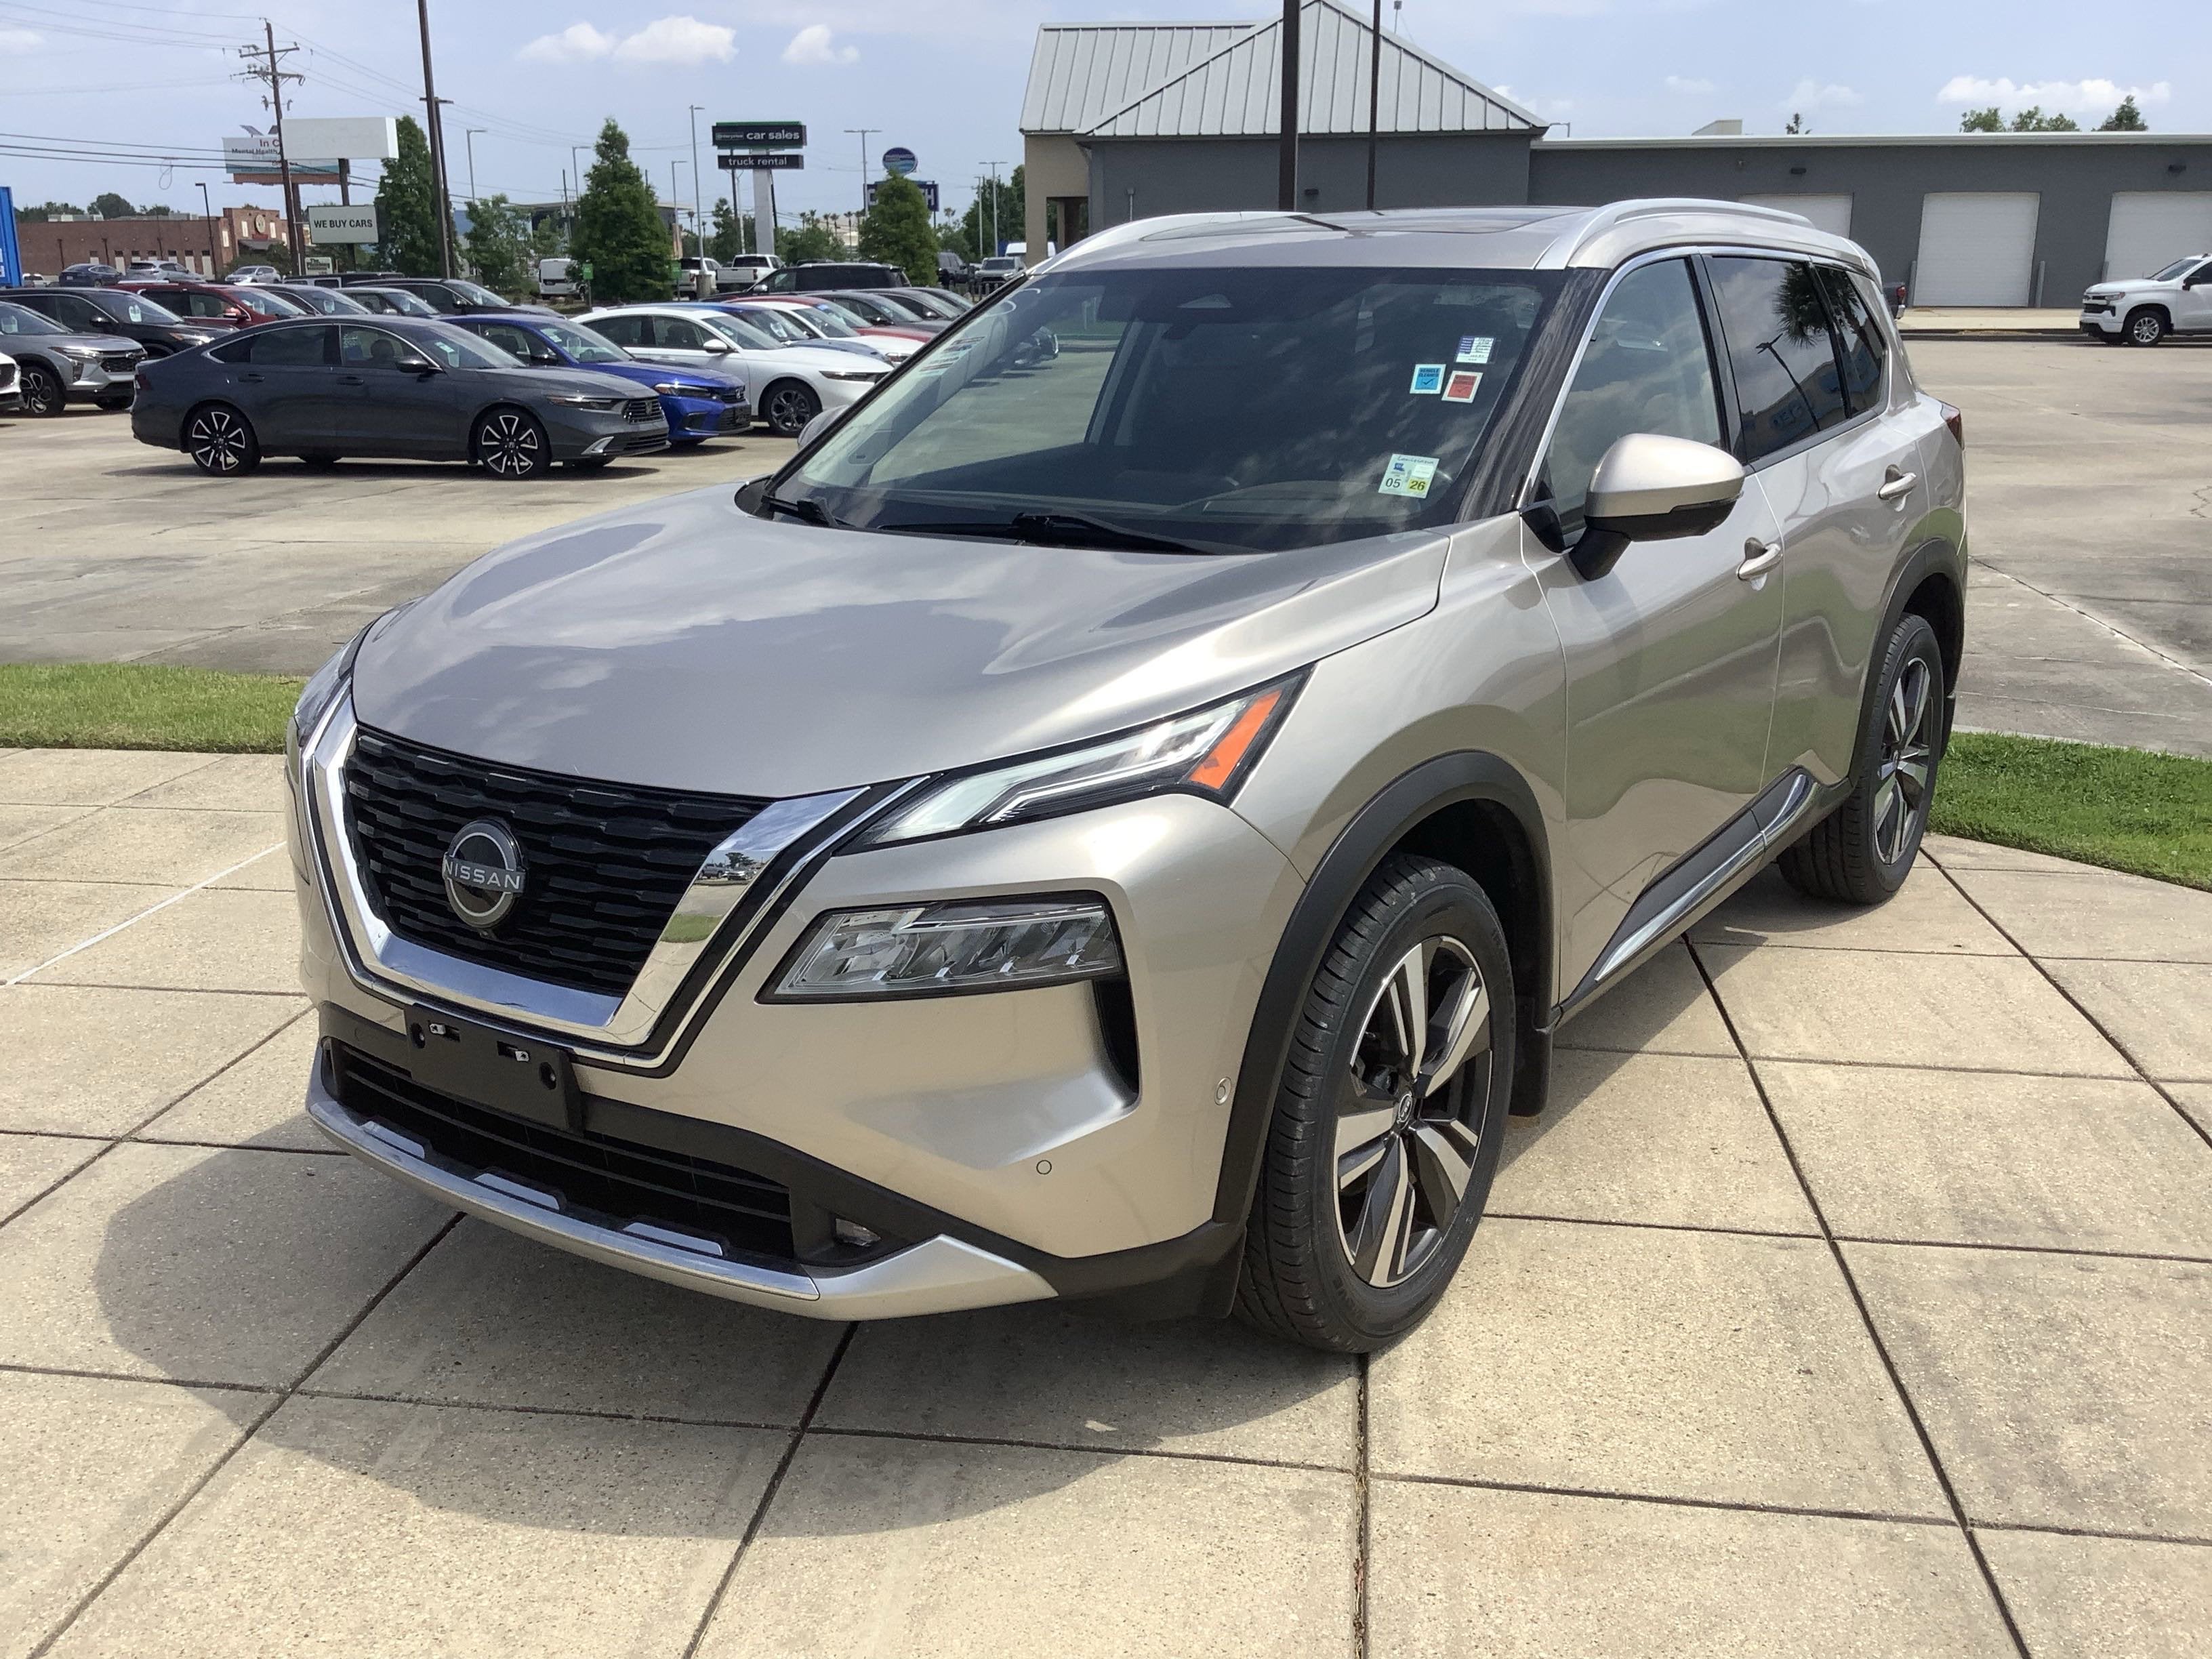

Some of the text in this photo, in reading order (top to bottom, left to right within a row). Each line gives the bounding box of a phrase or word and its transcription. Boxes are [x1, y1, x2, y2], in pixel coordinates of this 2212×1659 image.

[769, 129, 800, 140] sales
[260, 139, 269, 147] In
[729, 157, 787, 165] truck rental
[314, 219, 373, 228] WE BUY CARS
[1385, 478, 1426, 491] 05 26
[443, 859, 520, 889] NISSAN
